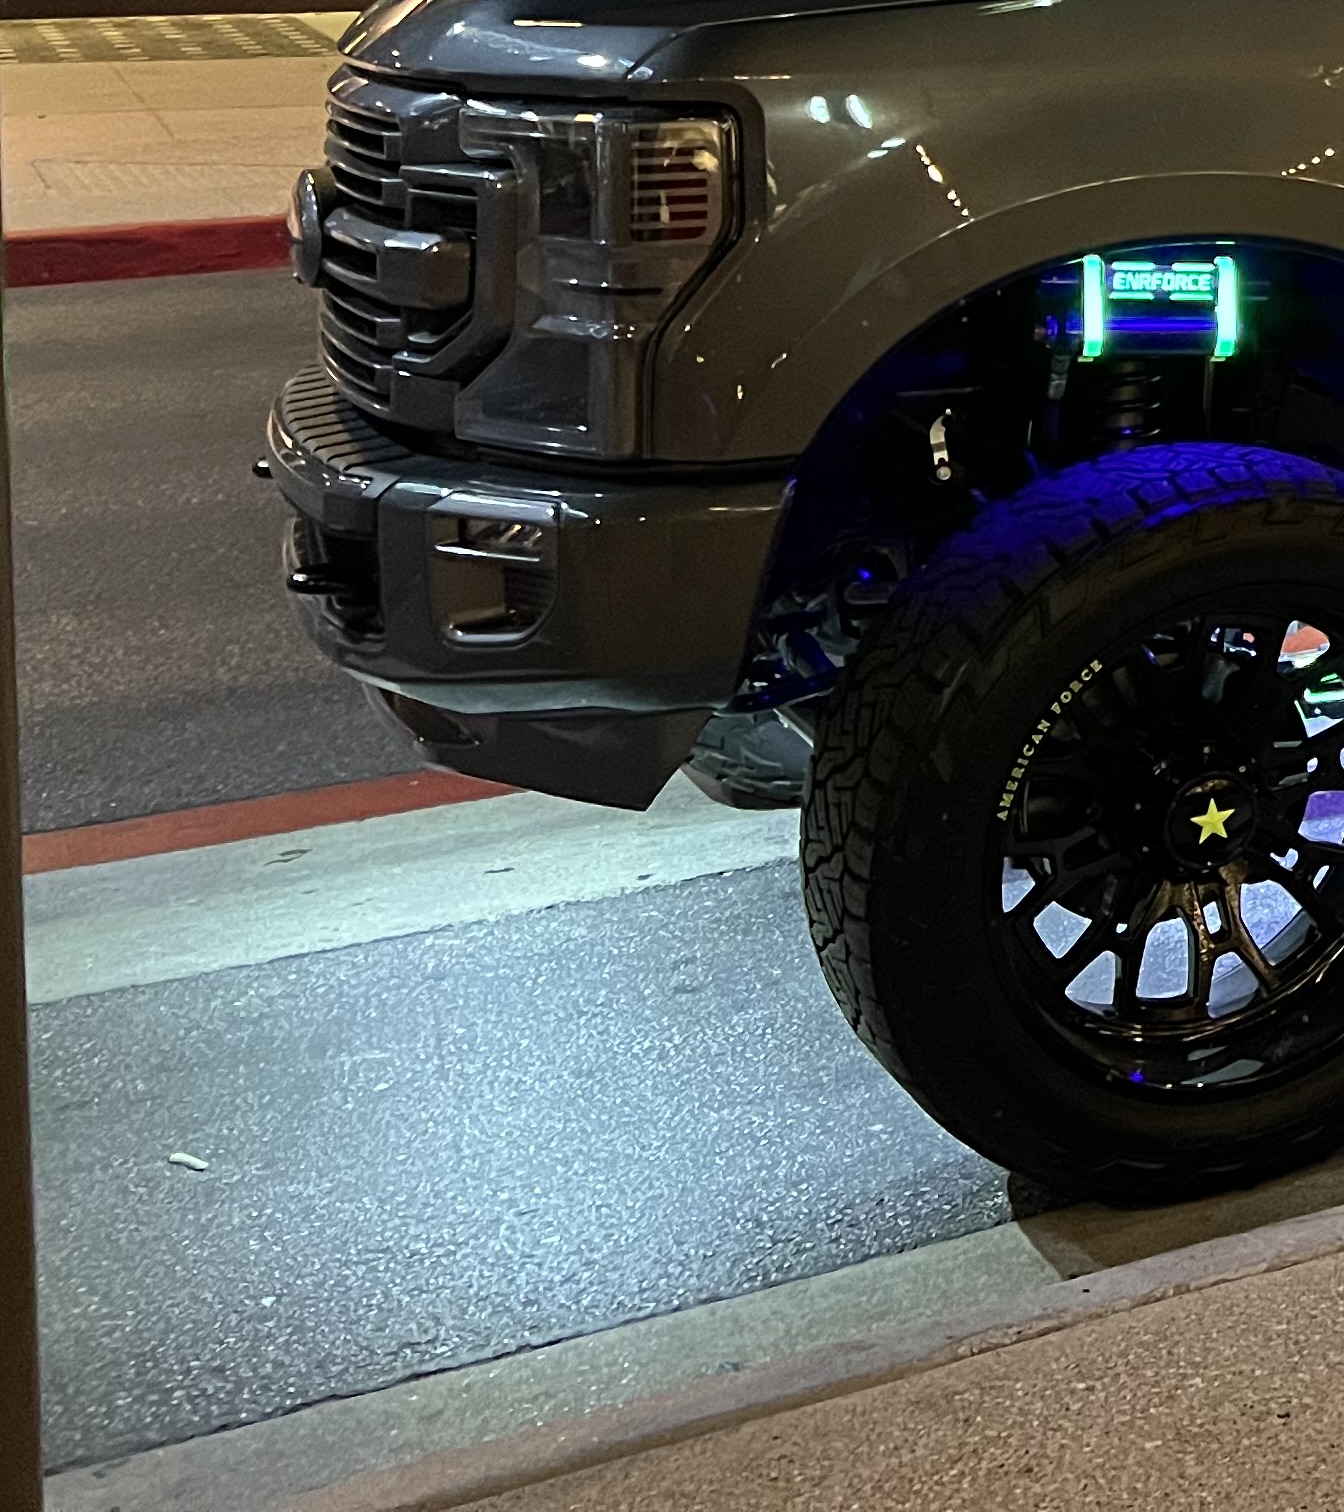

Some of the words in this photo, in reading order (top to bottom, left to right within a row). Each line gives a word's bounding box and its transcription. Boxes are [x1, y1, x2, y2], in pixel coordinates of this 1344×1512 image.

[1112, 271, 1213, 292] ENRFORCE
[996, 718, 1052, 822] AMERICAN
[1050, 658, 1103, 715] FORCE
